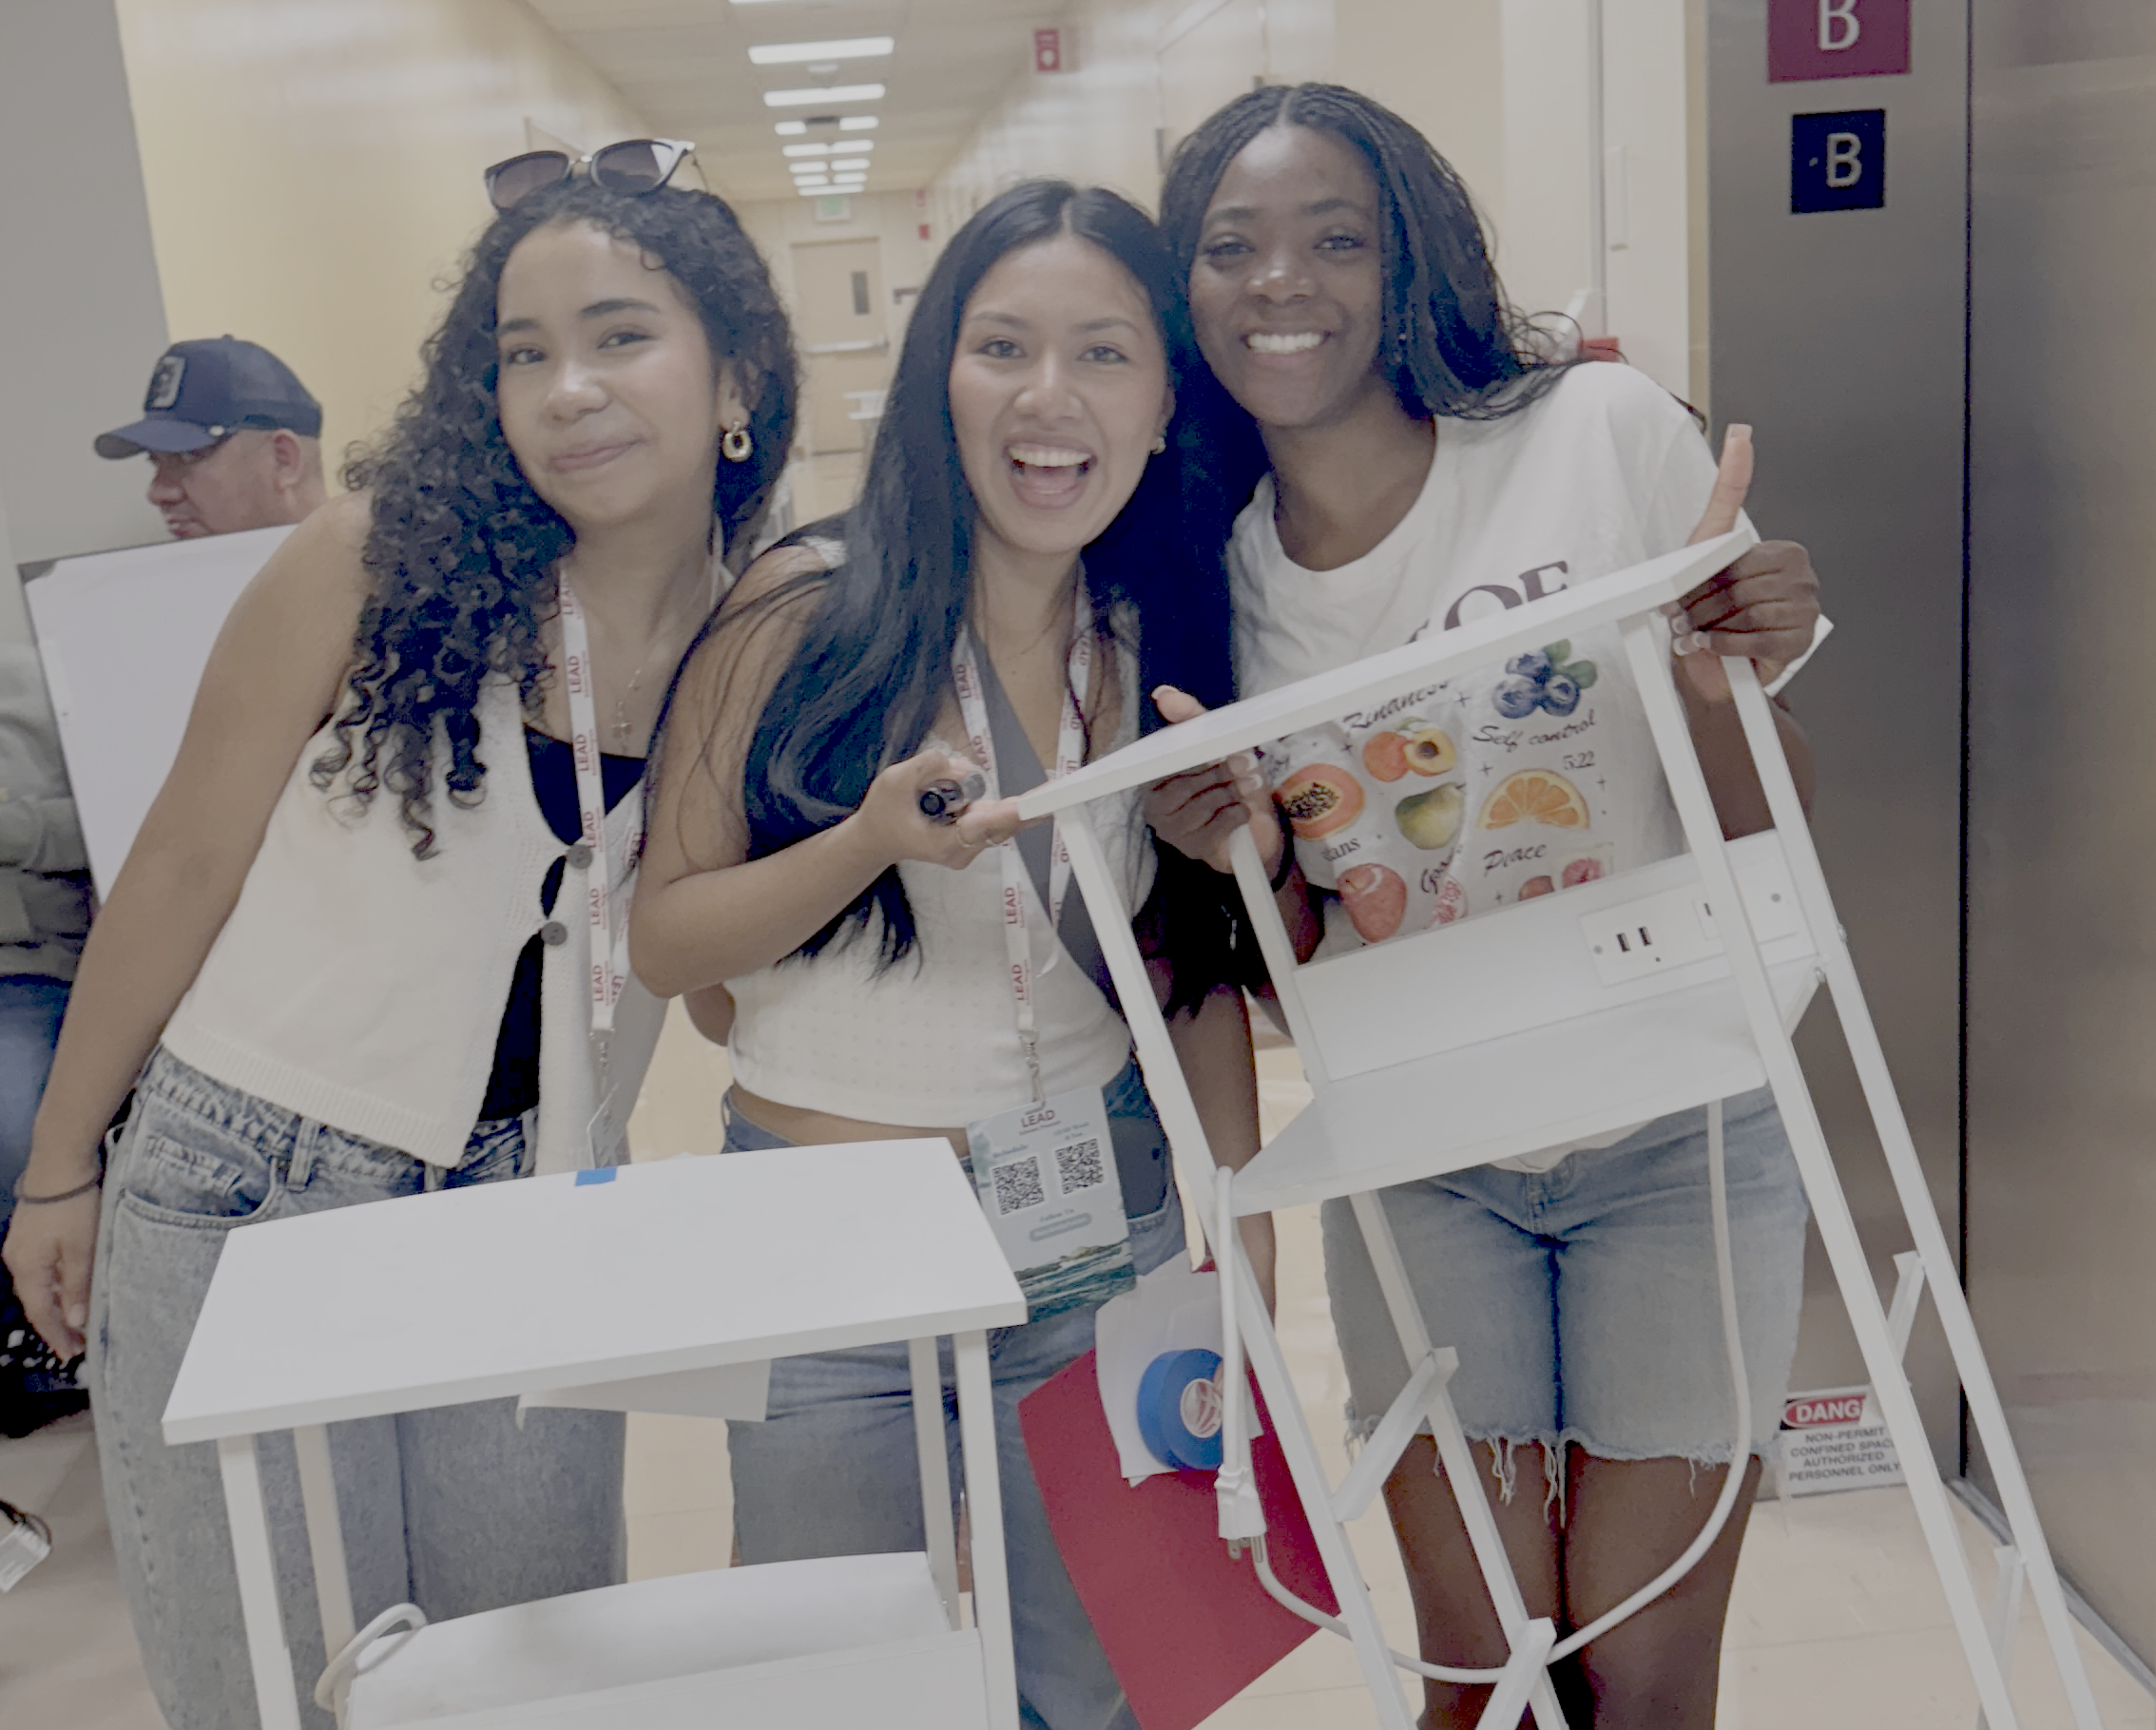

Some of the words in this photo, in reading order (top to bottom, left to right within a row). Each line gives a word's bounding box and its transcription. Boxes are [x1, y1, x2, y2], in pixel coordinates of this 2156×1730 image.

[1819, 0, 1860, 51] B
[1826, 132, 1862, 188] B
[568, 656, 582, 694] LEAD
[956, 664, 972, 699] LEAD
[574, 734, 589, 771] LEAD
[972, 735, 991, 771] LEAD
[583, 811, 597, 848] LEAD
[590, 888, 601, 926] LEAD
[1004, 887, 1018, 925] LEAD
[593, 965, 604, 1002] LEAD
[1011, 964, 1025, 1001] LEAD
[1021, 1109, 1055, 1128] LEAD
[1796, 1400, 1861, 1423] DANG
[1791, 1442, 1856, 1457] CONFINED
[1805, 1427, 1886, 1443] NON-PERMIT
[1789, 1467, 1864, 1482] PERSONNEL
[1868, 1463, 1900, 1474] ONLY
[1803, 1451, 1885, 1467] AUTHORIZED
